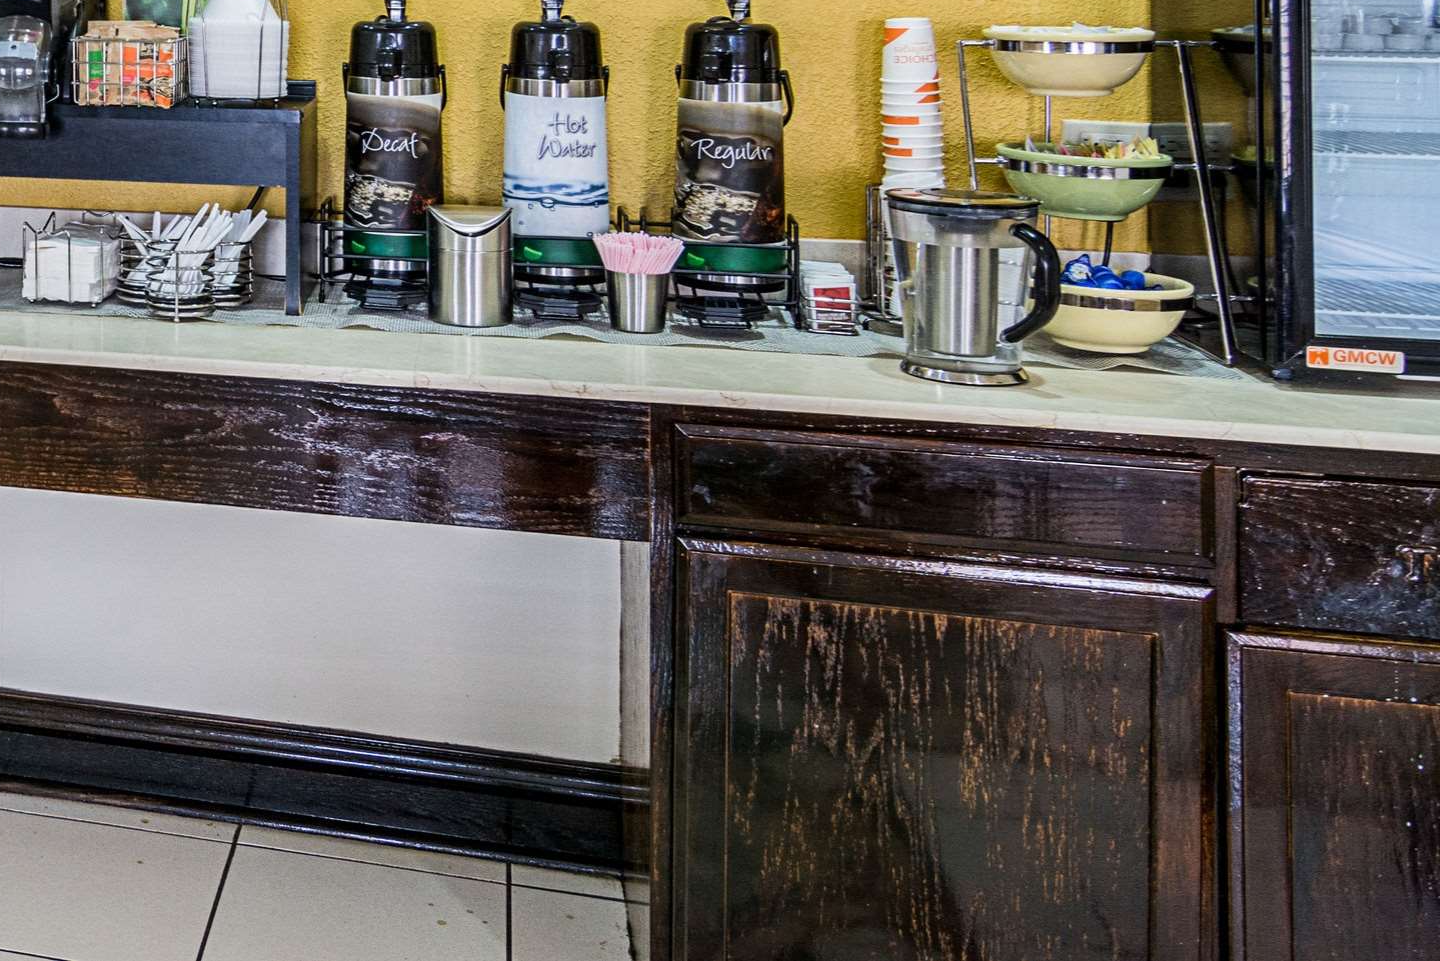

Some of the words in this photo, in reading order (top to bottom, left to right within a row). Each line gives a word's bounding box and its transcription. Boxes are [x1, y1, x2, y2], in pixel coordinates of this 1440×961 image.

[547, 112, 588, 136] Hot
[360, 127, 419, 159] Decaf
[537, 135, 597, 160] Water
[690, 138, 771, 169] Regular
[1333, 349, 1396, 365] GMCW
